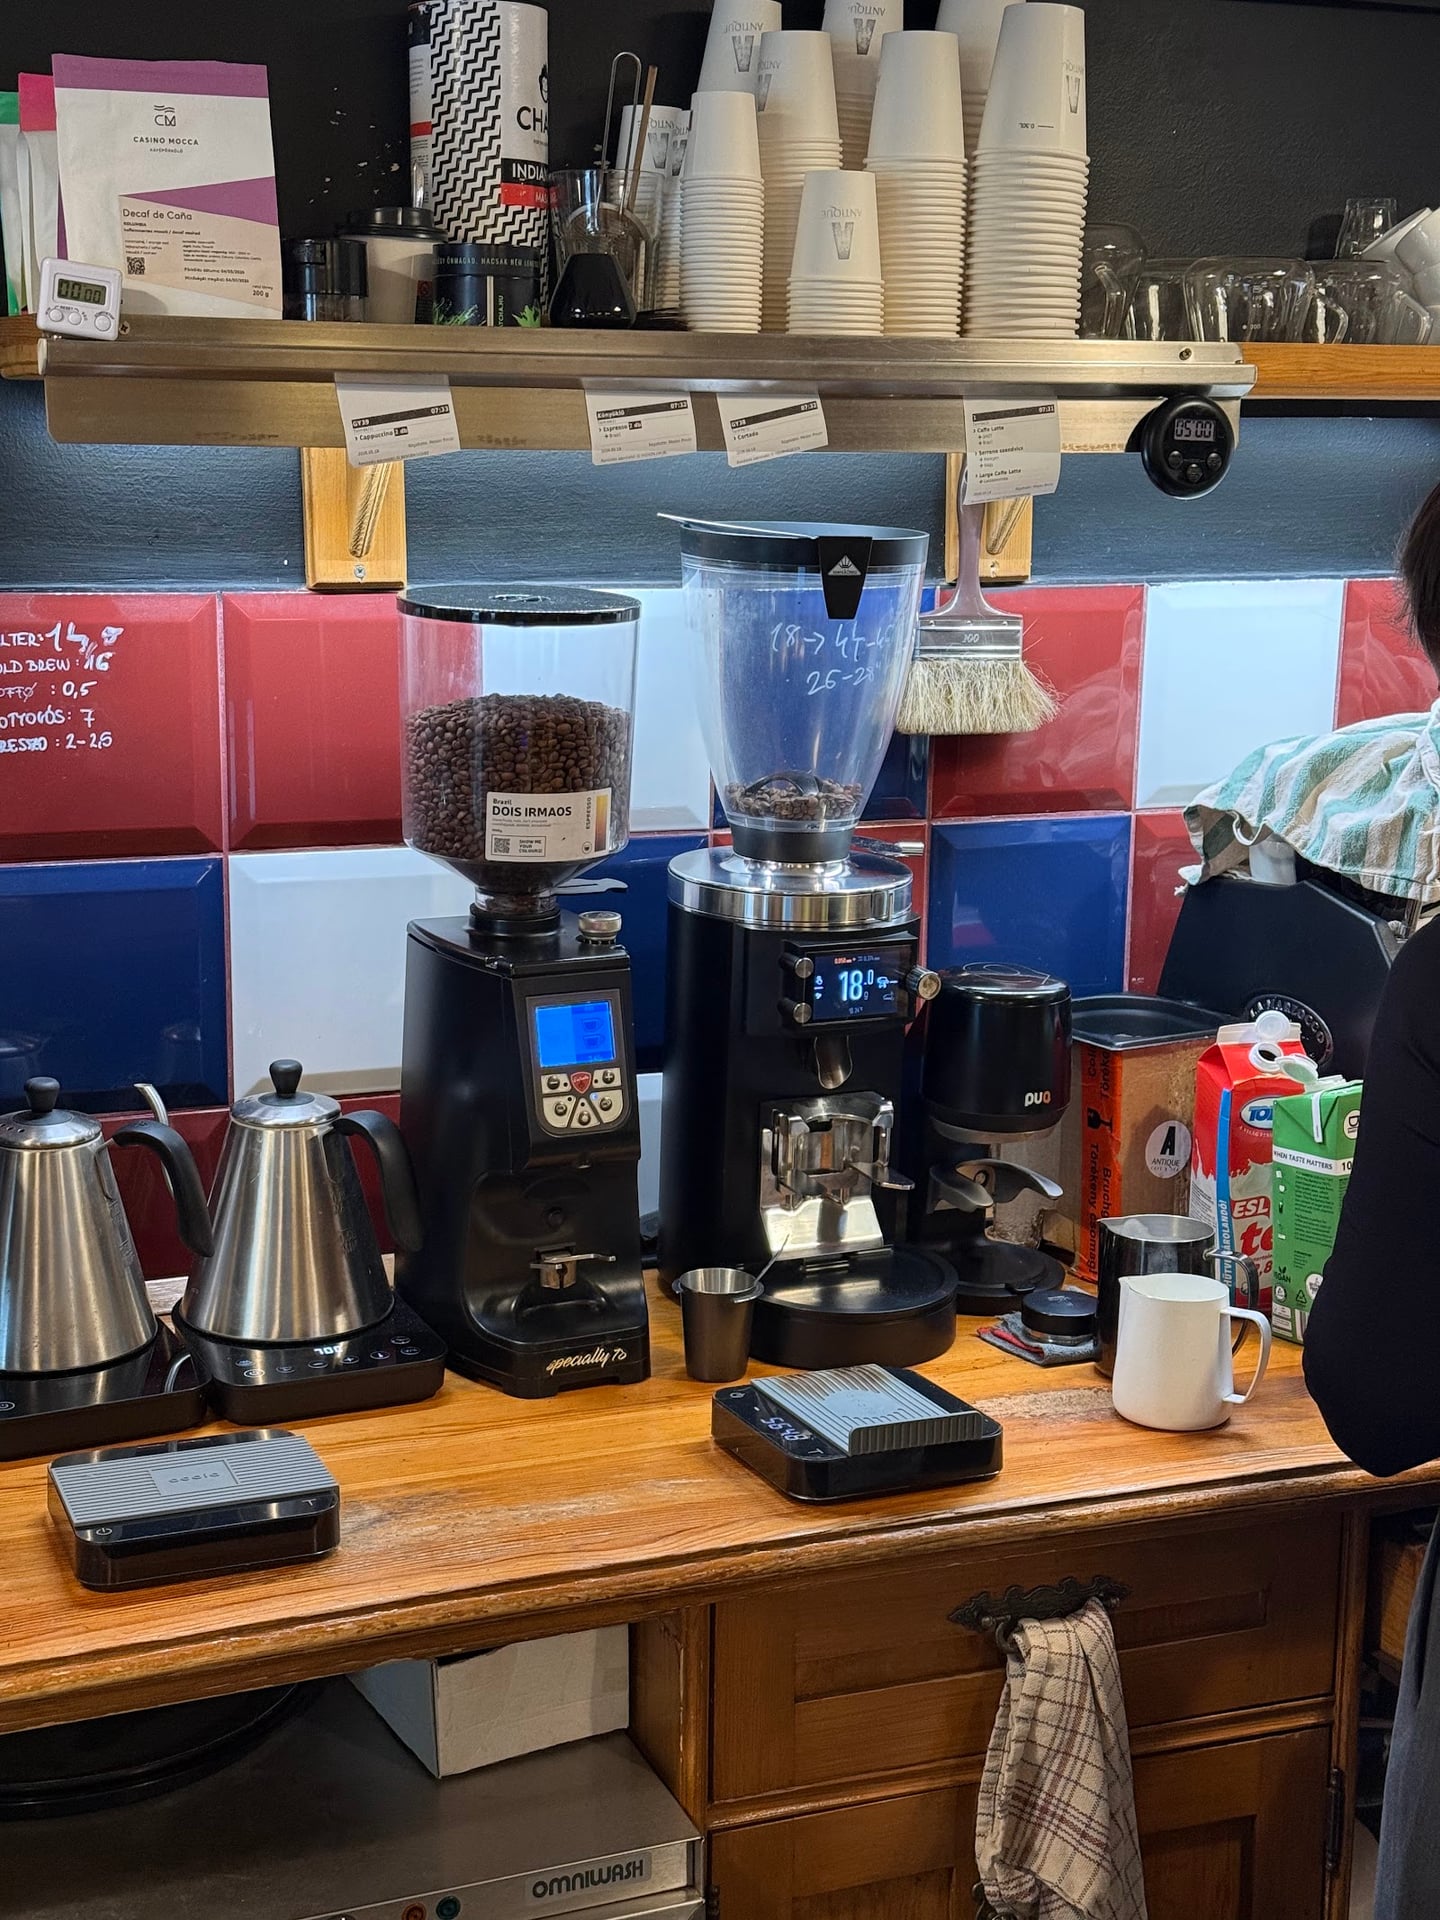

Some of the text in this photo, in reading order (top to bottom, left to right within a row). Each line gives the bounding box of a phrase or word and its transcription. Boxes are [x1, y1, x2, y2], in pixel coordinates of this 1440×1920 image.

[133, 136, 199, 145] CASINO MOCCA
[122, 208, 193, 221] Decaf de Caña
[359, 430, 393, 441] Cappuccino
[26, 658, 70, 672] BREW
[80, 708, 95, 728] 7
[492, 806, 572, 817] DOIS IRMAOS
[1160, 1126, 1176, 1155] A
[1151, 1158, 1180, 1168] ANTIQUE
[1288, 1154, 1306, 1164] TASTE
[1306, 1159, 1333, 1170] MATTERS
[1233, 1198, 1269, 1218] ESL
[532, 1859, 644, 1898] OMNIWASH
